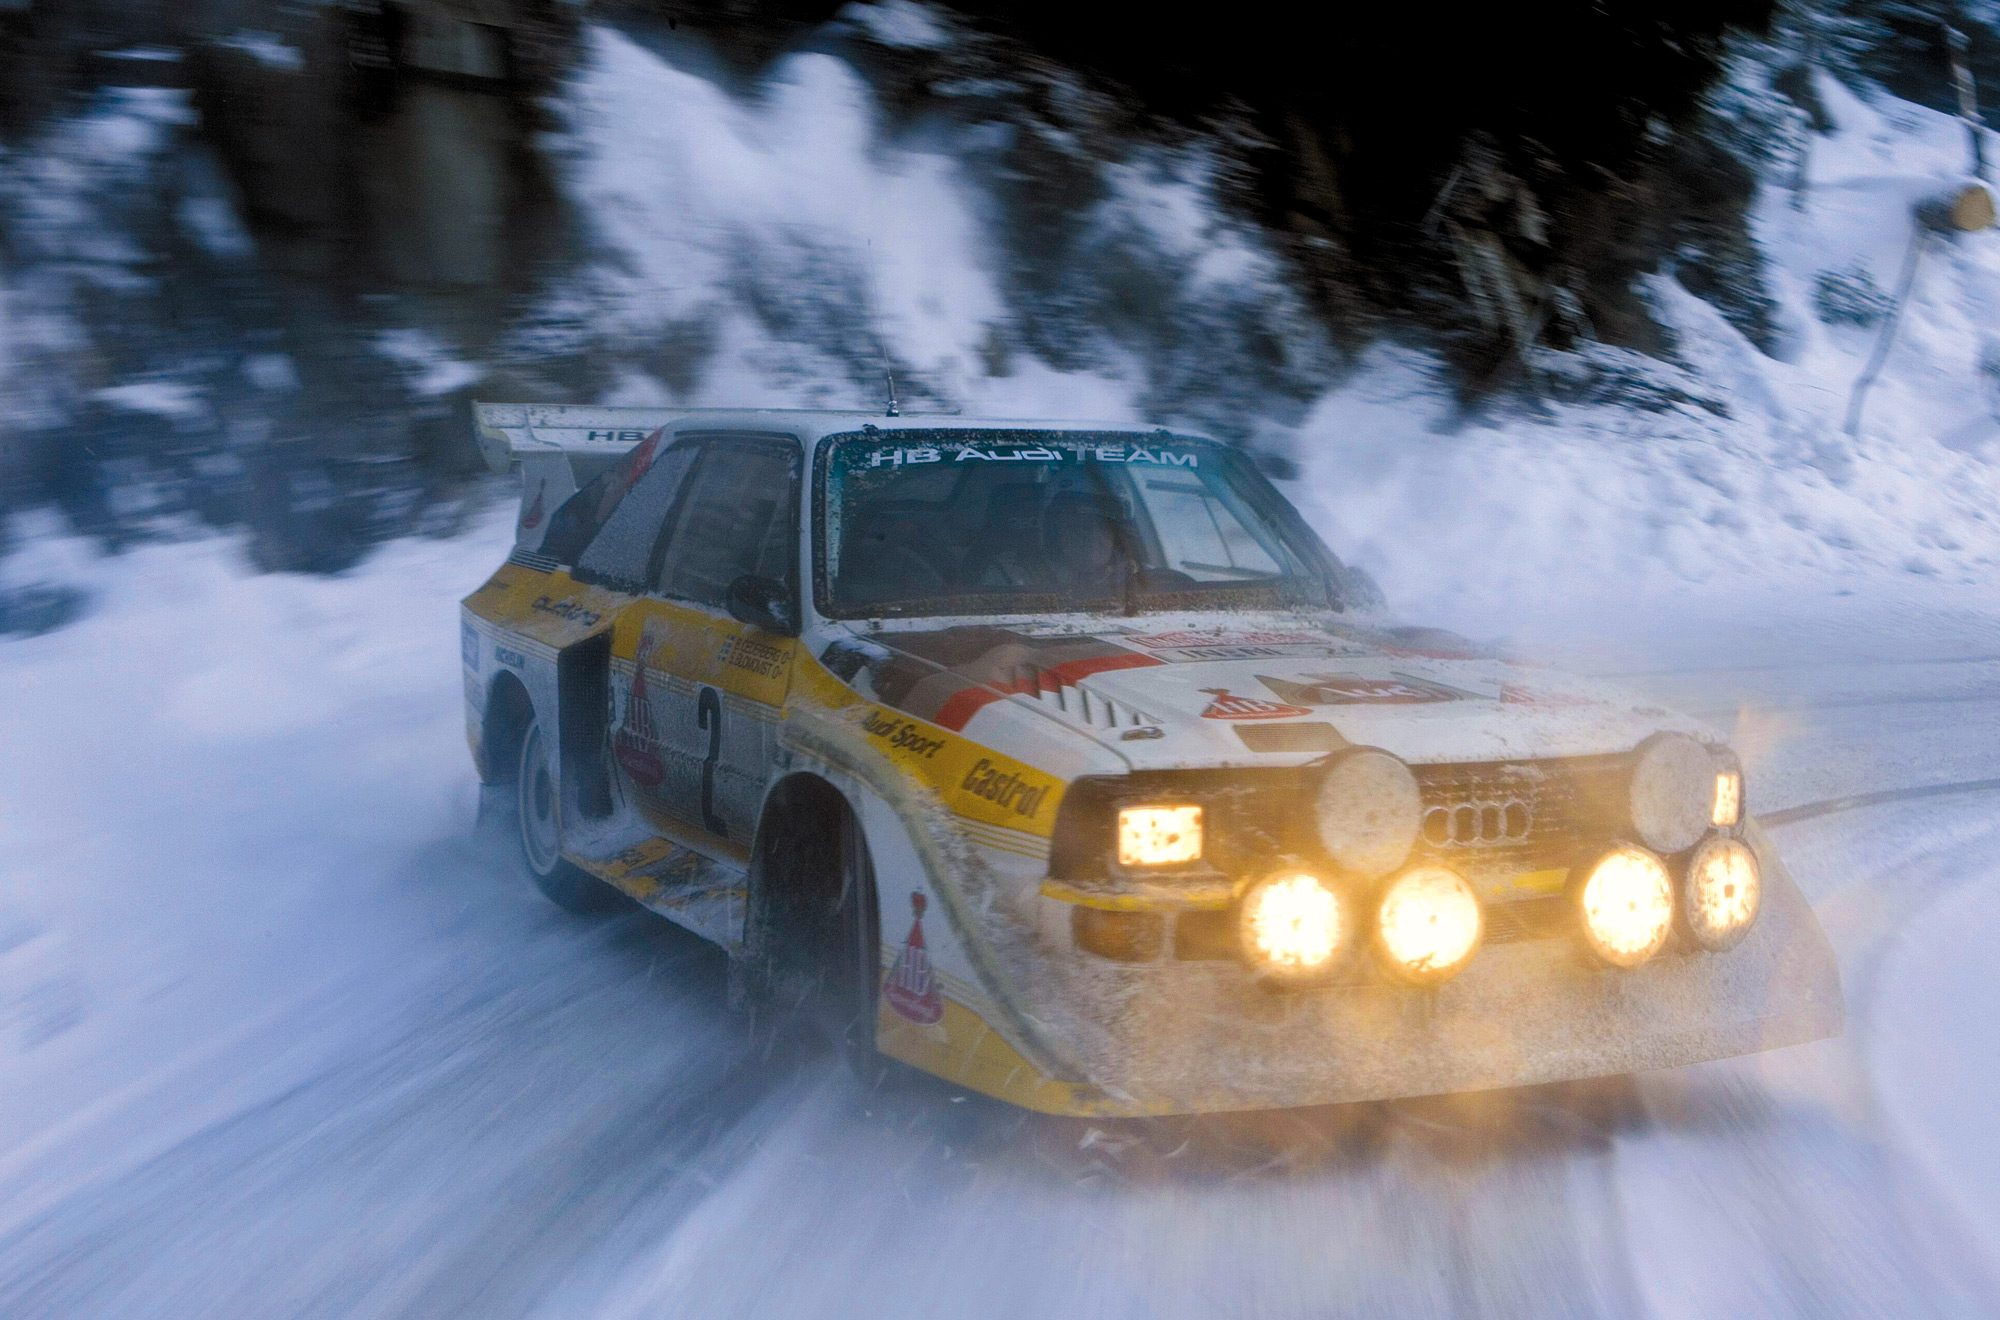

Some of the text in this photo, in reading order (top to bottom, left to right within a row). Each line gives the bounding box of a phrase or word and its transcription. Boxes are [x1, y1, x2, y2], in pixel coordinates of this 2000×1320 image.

[588, 431, 646, 441] HB
[871, 447, 1198, 467] HB Audi TEAM
[863, 710, 947, 759] Audi Sport
[961, 758, 1050, 819] Castrol
